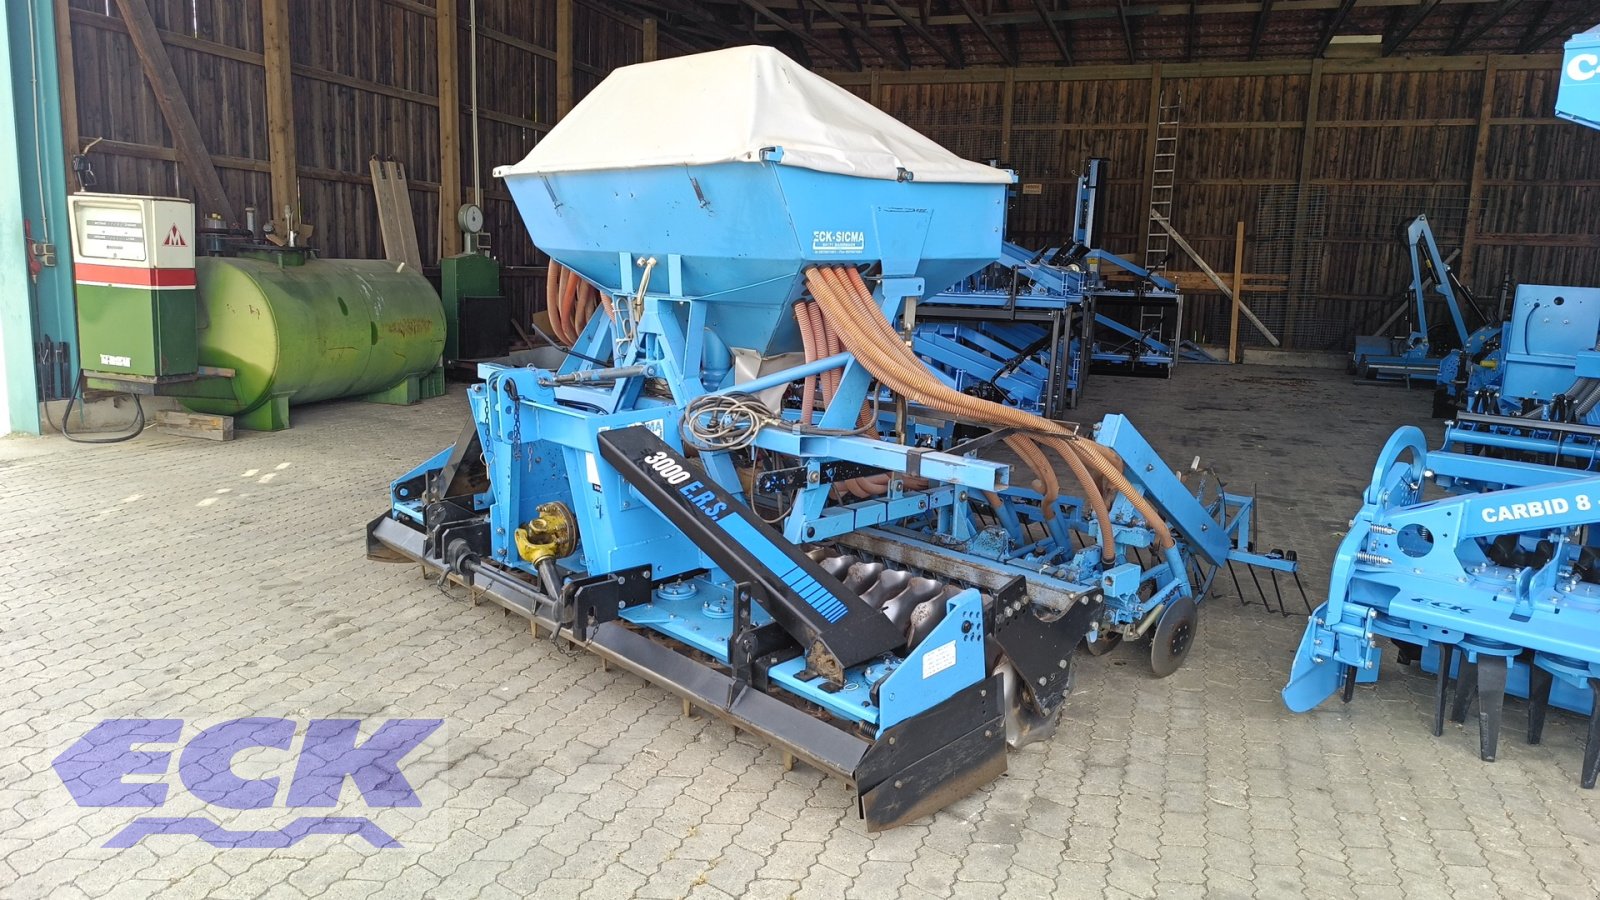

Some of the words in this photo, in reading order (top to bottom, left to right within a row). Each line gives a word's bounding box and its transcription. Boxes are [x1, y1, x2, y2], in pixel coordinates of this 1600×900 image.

[644, 451, 691, 485] 3000
[680, 481, 727, 521] E.R.S.
[1481, 498, 1569, 522] CARBID
[1575, 494, 1591, 510] 8
